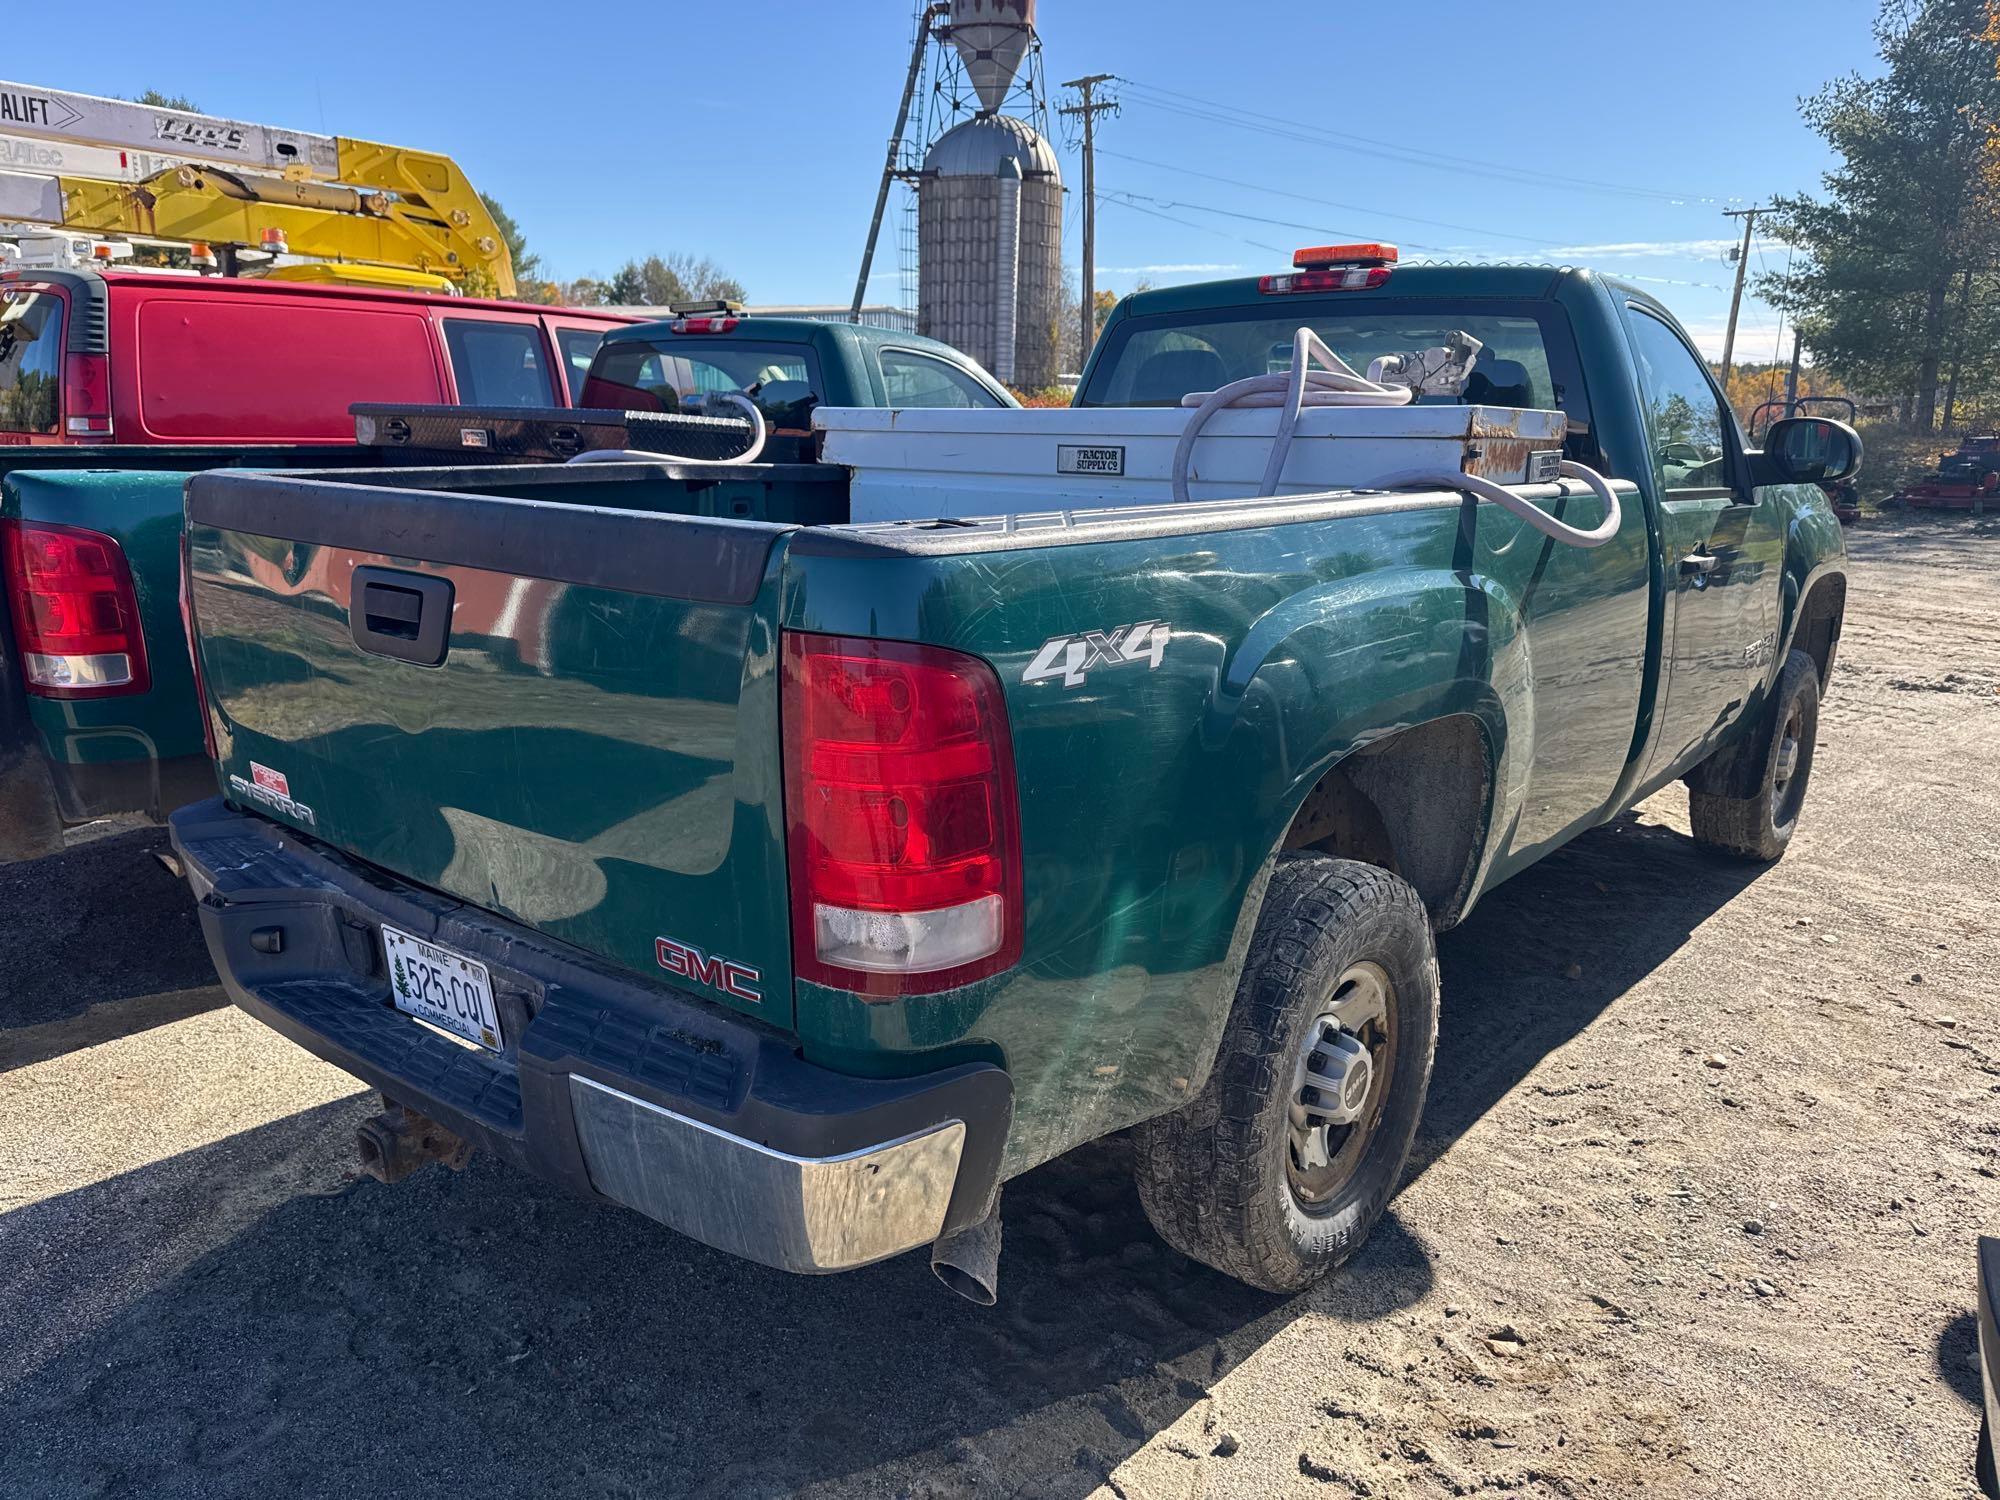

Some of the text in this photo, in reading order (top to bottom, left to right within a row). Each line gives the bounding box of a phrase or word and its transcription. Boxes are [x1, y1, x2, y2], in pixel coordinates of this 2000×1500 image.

[1, 93, 49, 126] ALIFT
[1077, 450, 1118, 460] TRACTOR
[1077, 460, 1107, 470] SUPPLY
[229, 774, 316, 826] SIERRA
[417, 943, 451, 968] MAINE
[655, 936, 761, 1004] GMC
[417, 1003, 476, 1037] COMMERCIAL
[1345, 1069, 1367, 1101] GMC
